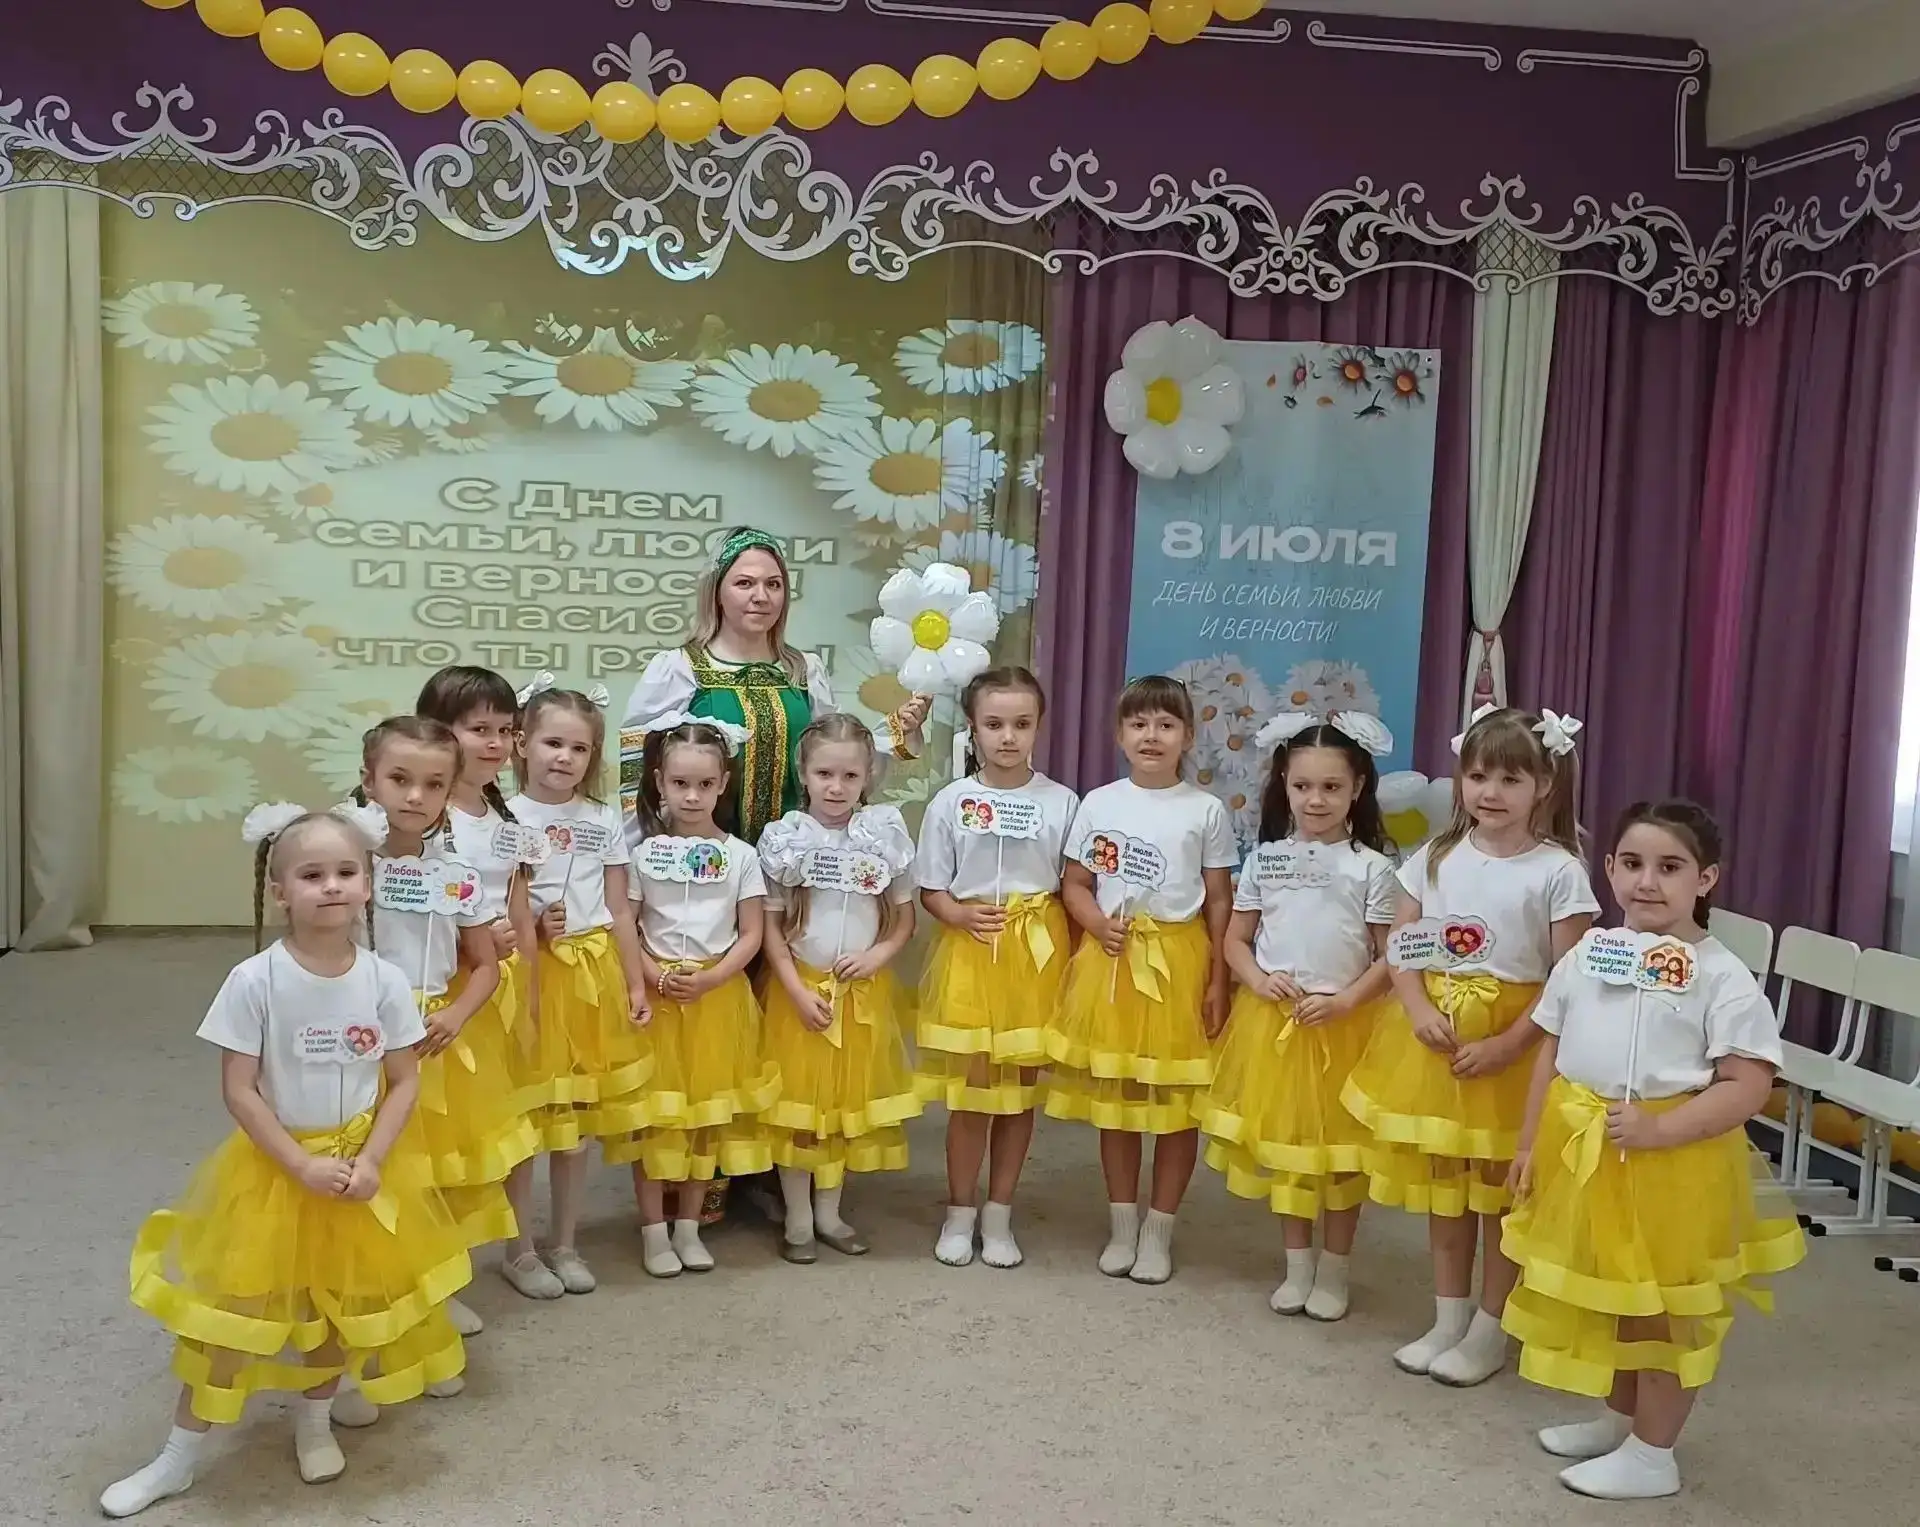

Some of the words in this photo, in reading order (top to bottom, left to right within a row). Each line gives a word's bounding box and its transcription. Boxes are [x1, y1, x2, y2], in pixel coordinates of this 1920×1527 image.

[442, 477, 498, 511] С
[511, 481, 721, 521] Днем
[314, 519, 579, 560] семьи,
[592, 527, 836, 564] люи
[1161, 520, 1203, 559] 8
[1219, 524, 1398, 567] ИЮЛЯ
[355, 560, 402, 588] и
[427, 562, 800, 600] вернос!
[1153, 580, 1216, 604] ДЕНЬ
[1308, 586, 1383, 610] ЛЮБВИ
[414, 597, 696, 634] Спасиб
[1200, 615, 1218, 640] И
[1222, 617, 1340, 643] ВЕРНОСТИ!
[336, 639, 458, 667] что
[475, 642, 565, 668] ты
[991, 800, 1007, 808] Пусть
[651, 841, 672, 850] Семья
[1122, 851, 1138, 861] День
[1132, 848, 1153, 857] июля
[1257, 852, 1291, 865] Верность
[384, 863, 422, 877] Любовь
[653, 865, 668, 874] мир!
[1124, 861, 1145, 871] любви
[1124, 868, 1154, 881] верности!
[399, 879, 422, 887] когда
[407, 888, 429, 896] рядом
[391, 895, 428, 905] близкими!
[1401, 931, 1428, 942] Семья
[1594, 934, 1626, 947] Семья
[1413, 941, 1435, 950] самое
[1401, 948, 1433, 960] важное!
[1590, 945, 1603, 953] это
[1605, 948, 1636, 959] счастье,
[1586, 955, 1633, 968] поддержка
[1598, 966, 1629, 976] забота!
[306, 1026, 332, 1037] Семья
